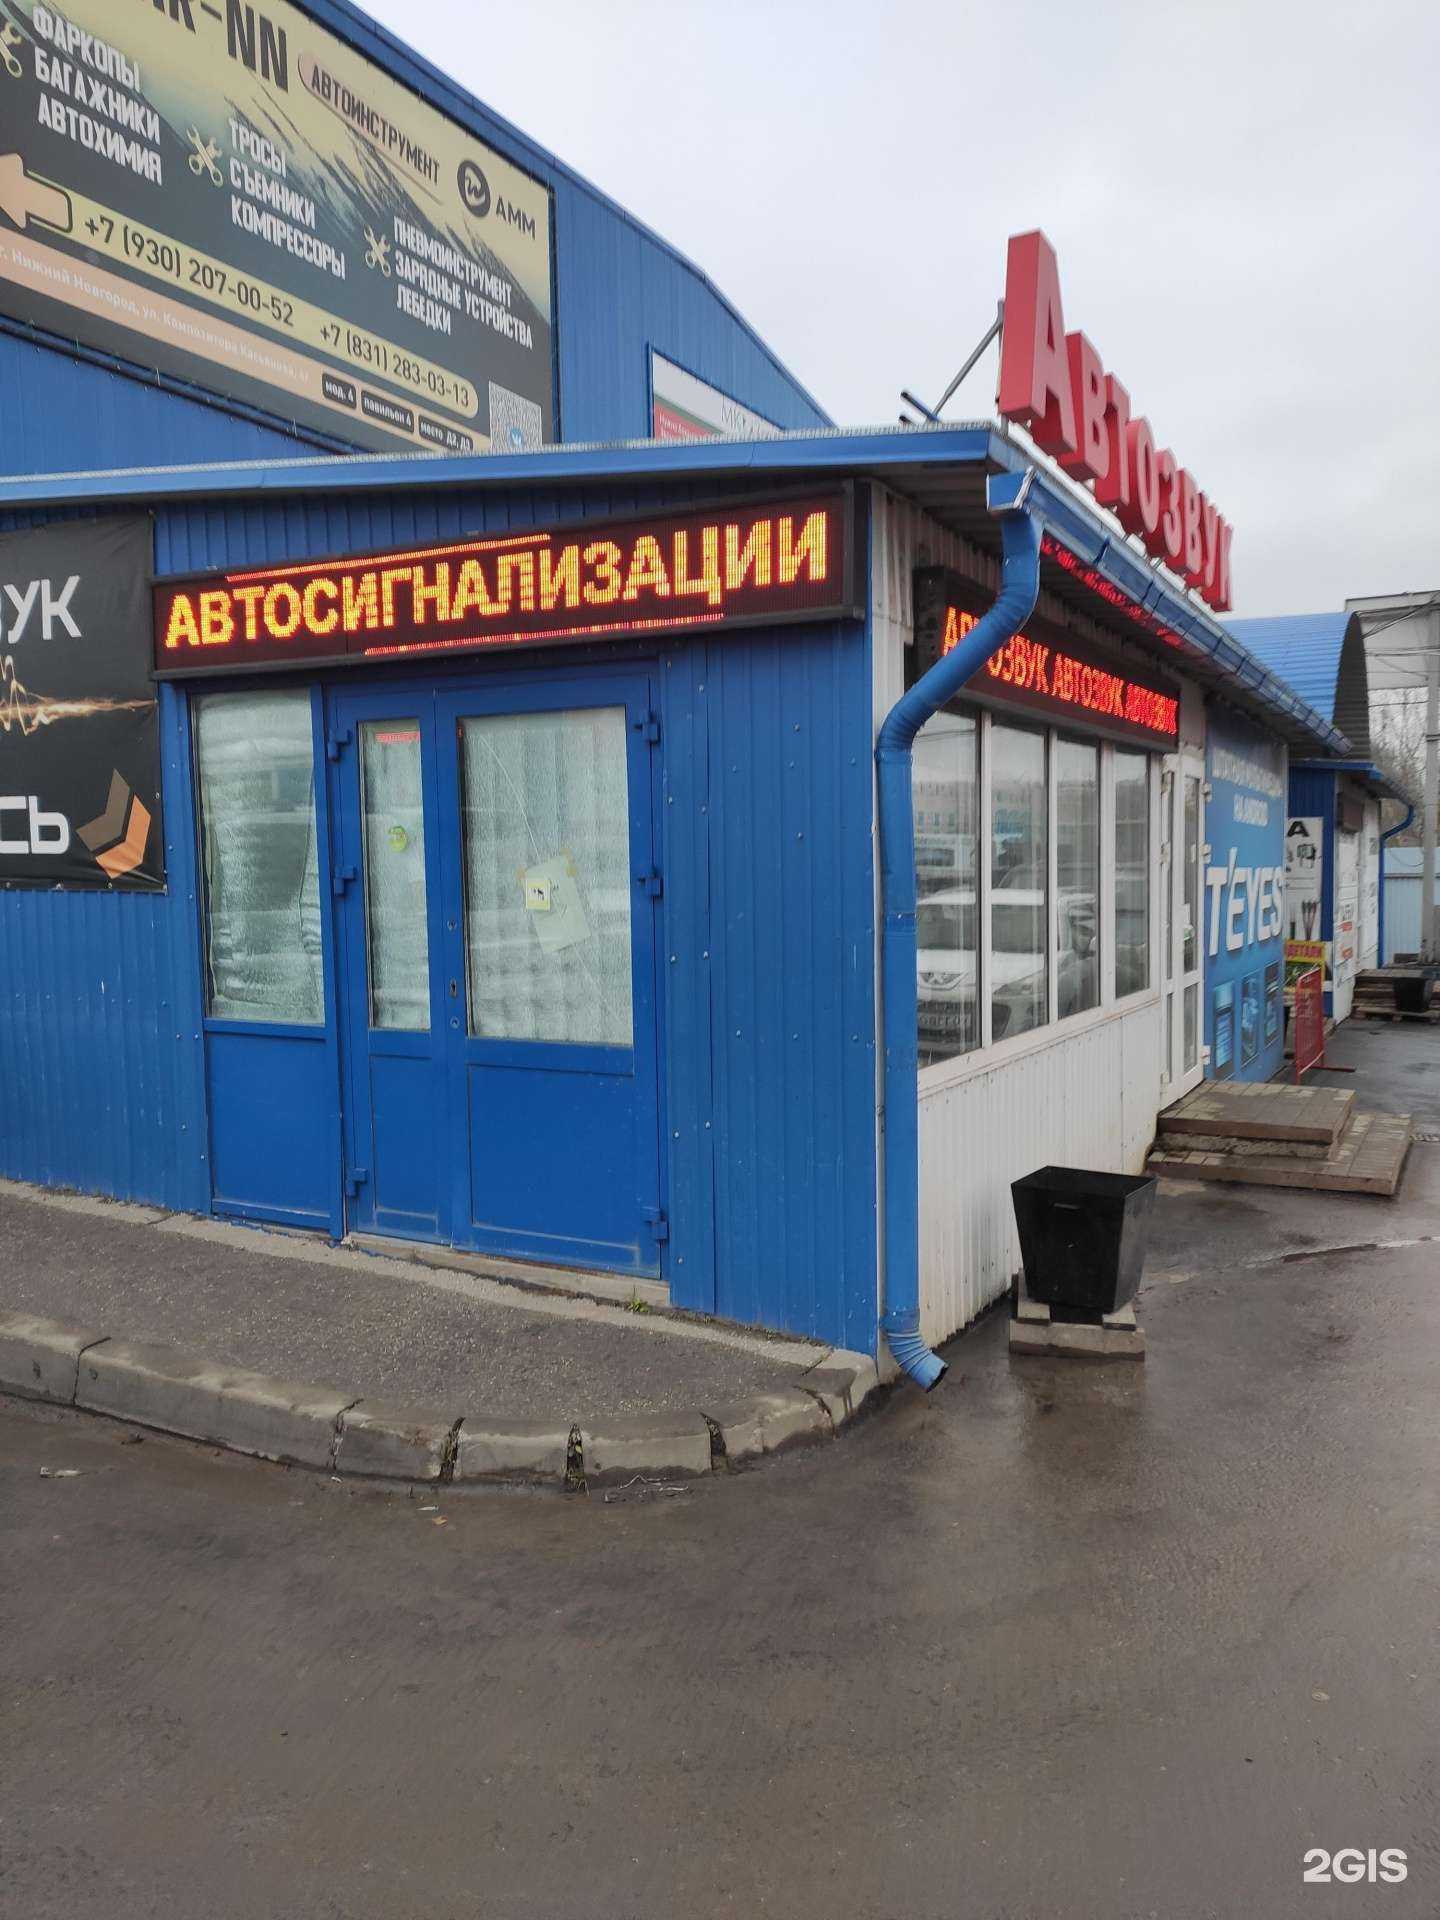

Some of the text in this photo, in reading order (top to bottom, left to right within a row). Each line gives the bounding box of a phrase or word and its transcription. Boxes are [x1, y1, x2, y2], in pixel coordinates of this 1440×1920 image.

[33, 6, 141, 92] ФАРКОПЫ
[152, 0, 288, 94] -NN
[34, 46, 161, 146] БАГАЖНИКИ
[38, 92, 163, 185] АВТОХИМИЯ
[311, 64, 440, 184] АВТОИНСТРУМЕНТ
[229, 117, 286, 178] ТРОСЫ
[230, 157, 315, 230] СЪЕМНИКИ
[85, 215, 294, 327] +7 (930) 207-00-52
[231, 195, 345, 280] КОМПРЕССОРЫ
[394, 216, 511, 308] ПНЕВМОИНСТРУМЕНТ
[395, 249, 533, 350] ЗАРЯДНЫЕ УСТРОЙСТВА
[397, 283, 451, 336] ЛЕБЕДКИ
[320, 323, 469, 408] +7 (831) 283-03-13
[1000, 228, 1233, 612] АВТОЗВУК
[0, 575, 82, 644] УК
[164, 511, 828, 648] АВТОСИГНАЛИЗАЦИИ
[943, 606, 1049, 694] АОЗВУК
